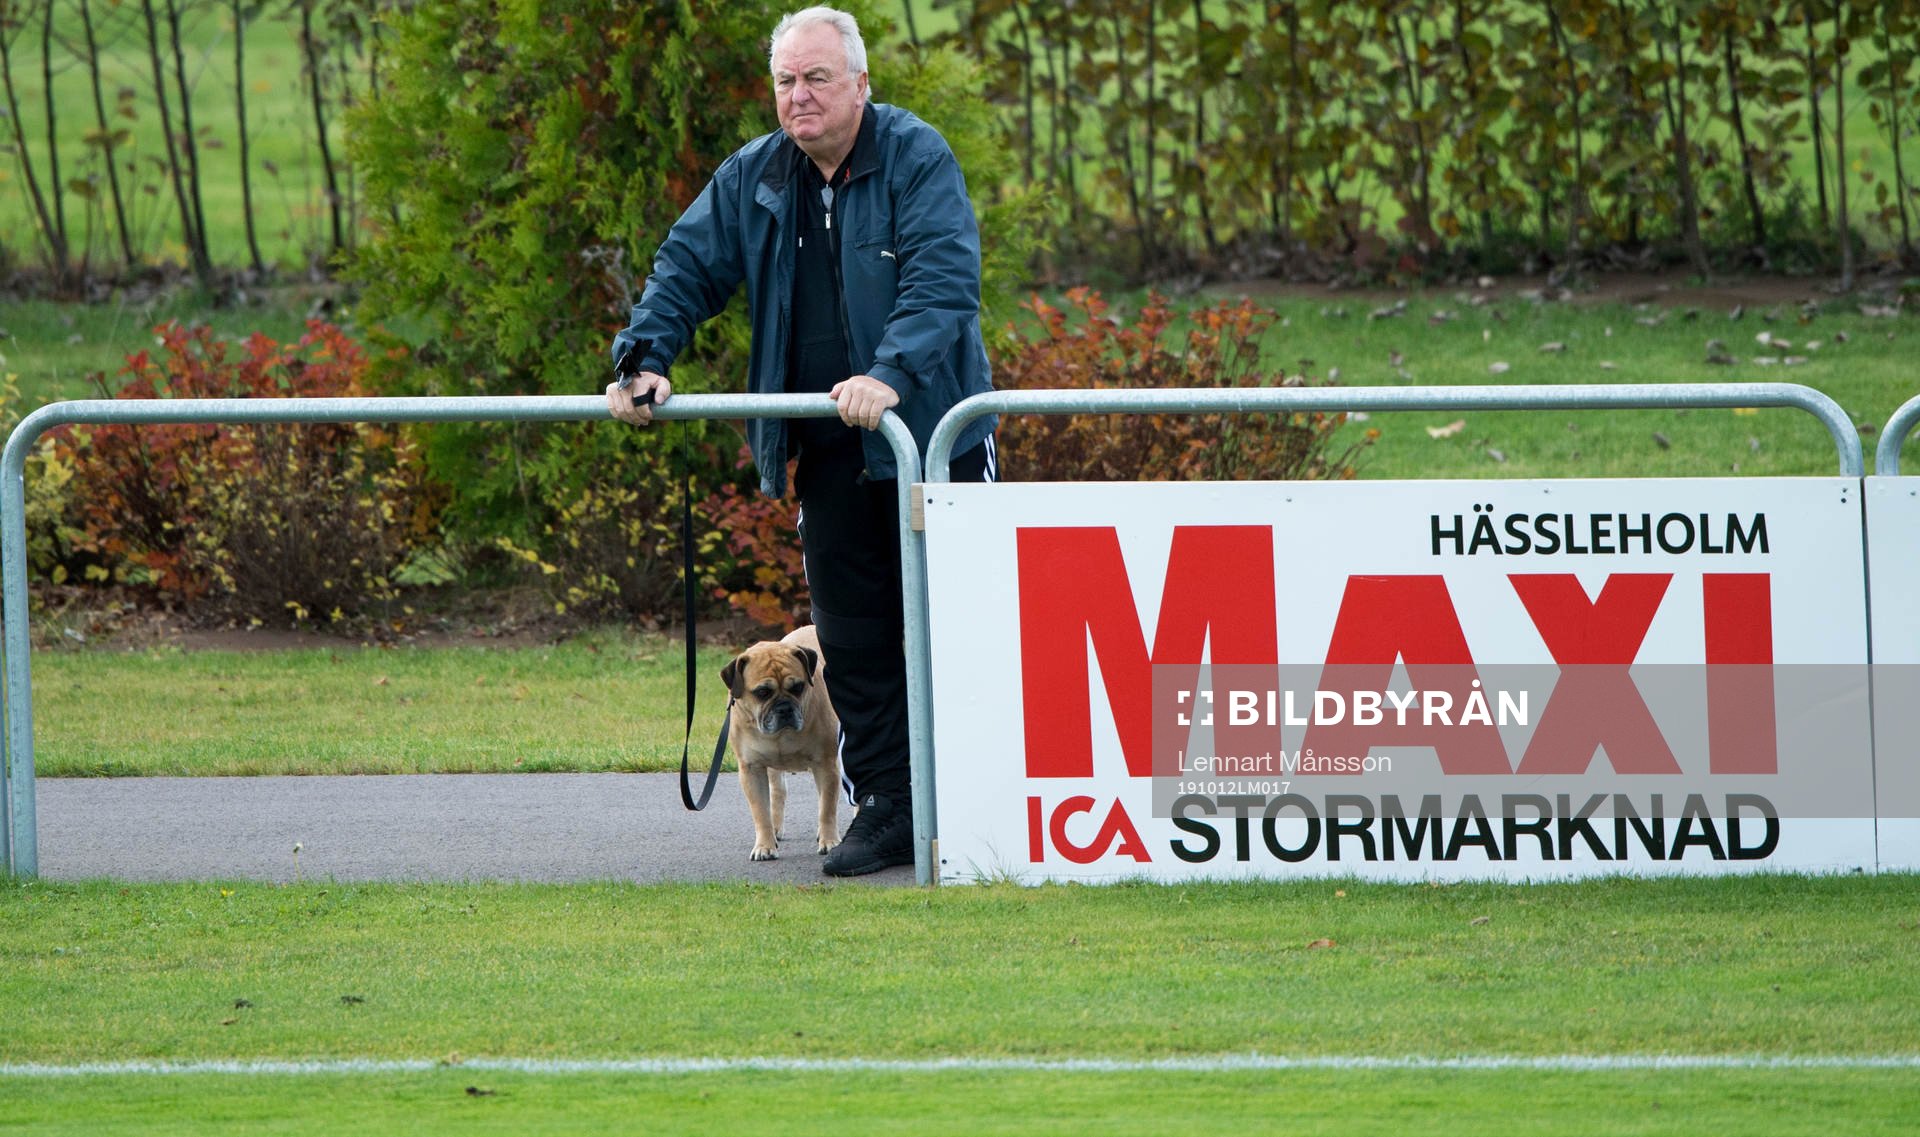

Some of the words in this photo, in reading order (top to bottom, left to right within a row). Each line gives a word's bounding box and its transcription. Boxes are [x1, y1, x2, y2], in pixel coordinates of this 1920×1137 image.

[1430, 504, 1770, 555] HÄSSLEHOLM
[1016, 525, 1778, 778] MAXI
[1027, 795, 1153, 864] ICA
[1169, 793, 1780, 863] STORMARKNAD
